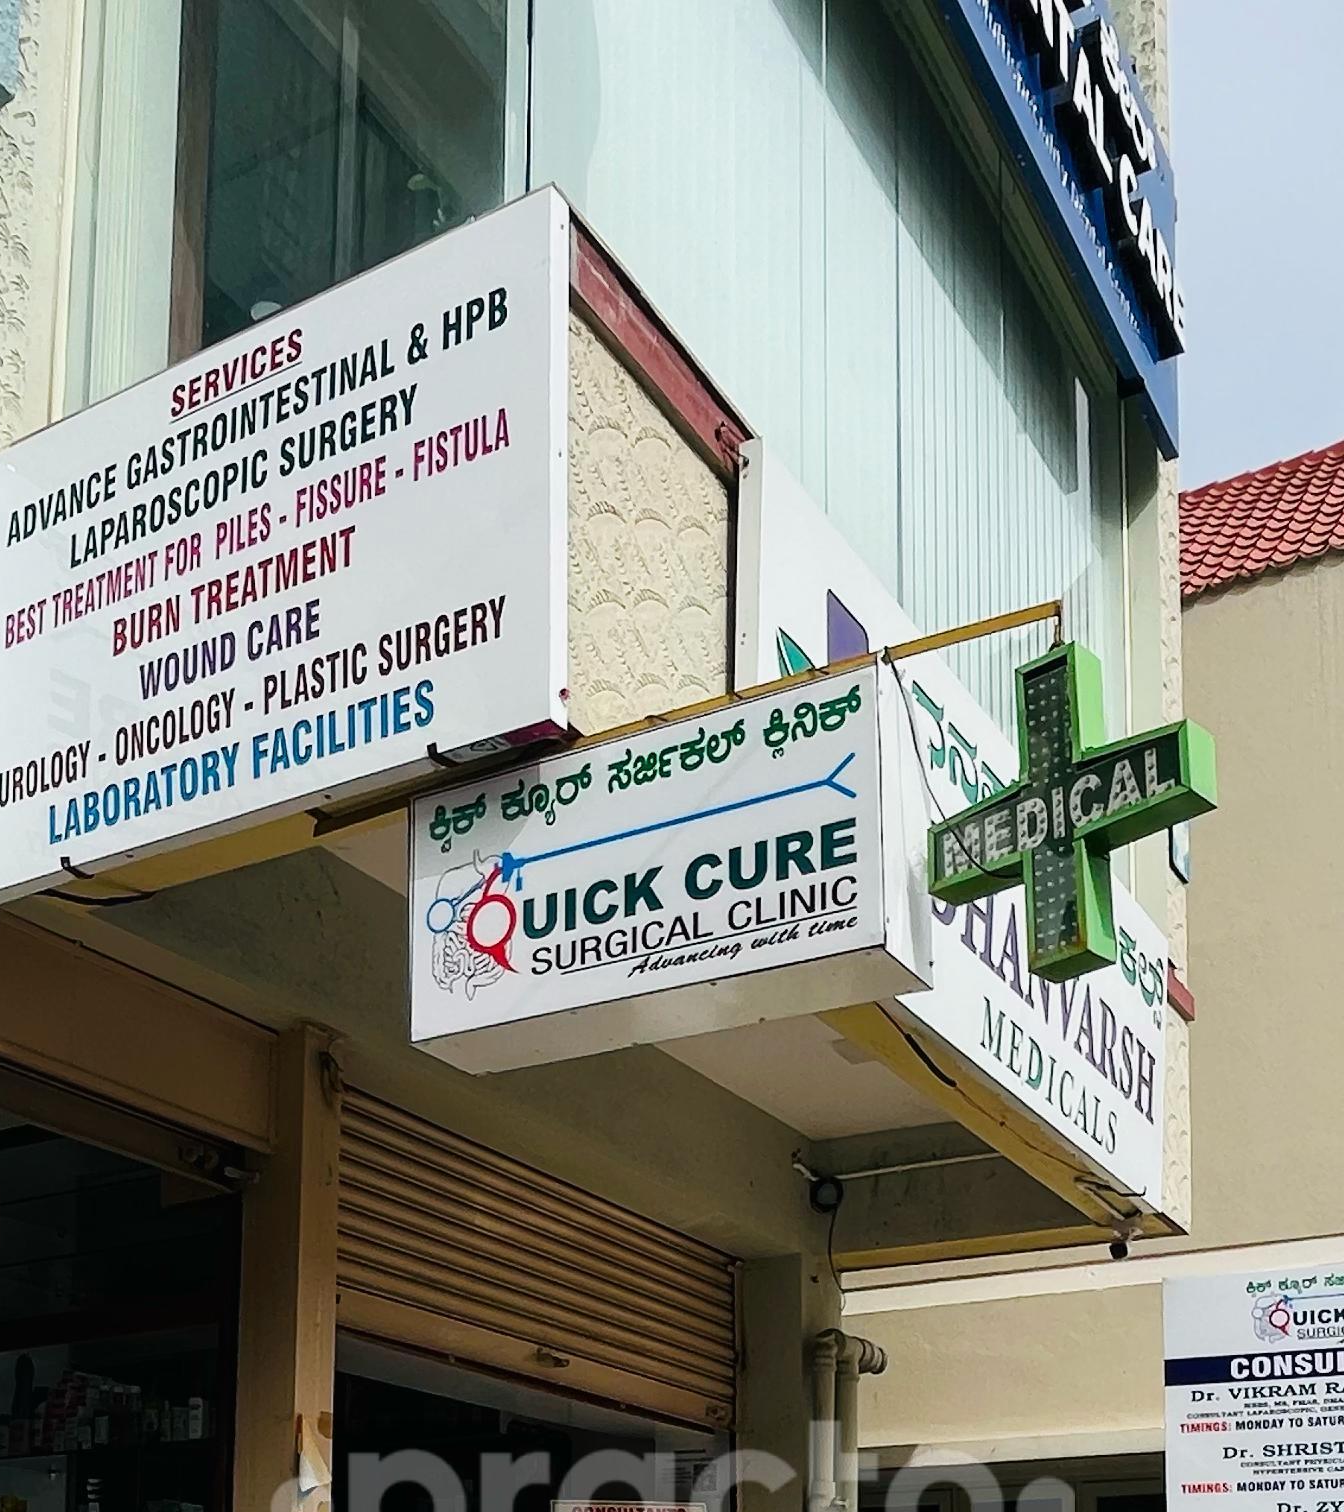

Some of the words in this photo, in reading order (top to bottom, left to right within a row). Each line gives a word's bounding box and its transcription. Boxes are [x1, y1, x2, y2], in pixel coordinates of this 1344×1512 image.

[7, 463, 117, 547] ADVANCE
[126, 339, 395, 490] GASTROINTESTINAL
[407, 323, 428, 364] &
[443, 286, 509, 352] HPB
[171, 328, 303, 417] SERVICES
[5, 600, 47, 649] BEST
[53, 551, 158, 628] TREATMENT
[164, 535, 201, 582] FOR
[216, 502, 271, 564] PILES
[296, 455, 387, 527] FISSURE
[413, 408, 510, 481] FISTULA
[70, 449, 268, 569] LAPAROSCOPIC
[279, 383, 418, 478] SURGERY
[113, 595, 181, 657] BURN
[190, 526, 357, 625] TREATMENT
[139, 625, 236, 700] WOUND
[247, 598, 321, 662] CARE
[115, 687, 235, 766] ONCOLOGY
[262, 644, 368, 715] PLASTIC
[379, 595, 507, 672] SURGERY
[49, 743, 240, 844] LABORATORY
[252, 679, 435, 779] FACILITIES
[940, 746, 1177, 876] MEDICAL
[684, 817, 856, 902] CURE
[531, 911, 714, 976] SURGICAL
[727, 875, 858, 930] CLINIC
[980, 996, 1118, 1155] MEDICALS
[1191, 1391, 1220, 1401] Dr.
[1229, 1383, 1316, 1399] VIKRAM
[1223, 1447, 1253, 1459] Dr.
[1236, 1419, 1284, 1431] MONDAY
